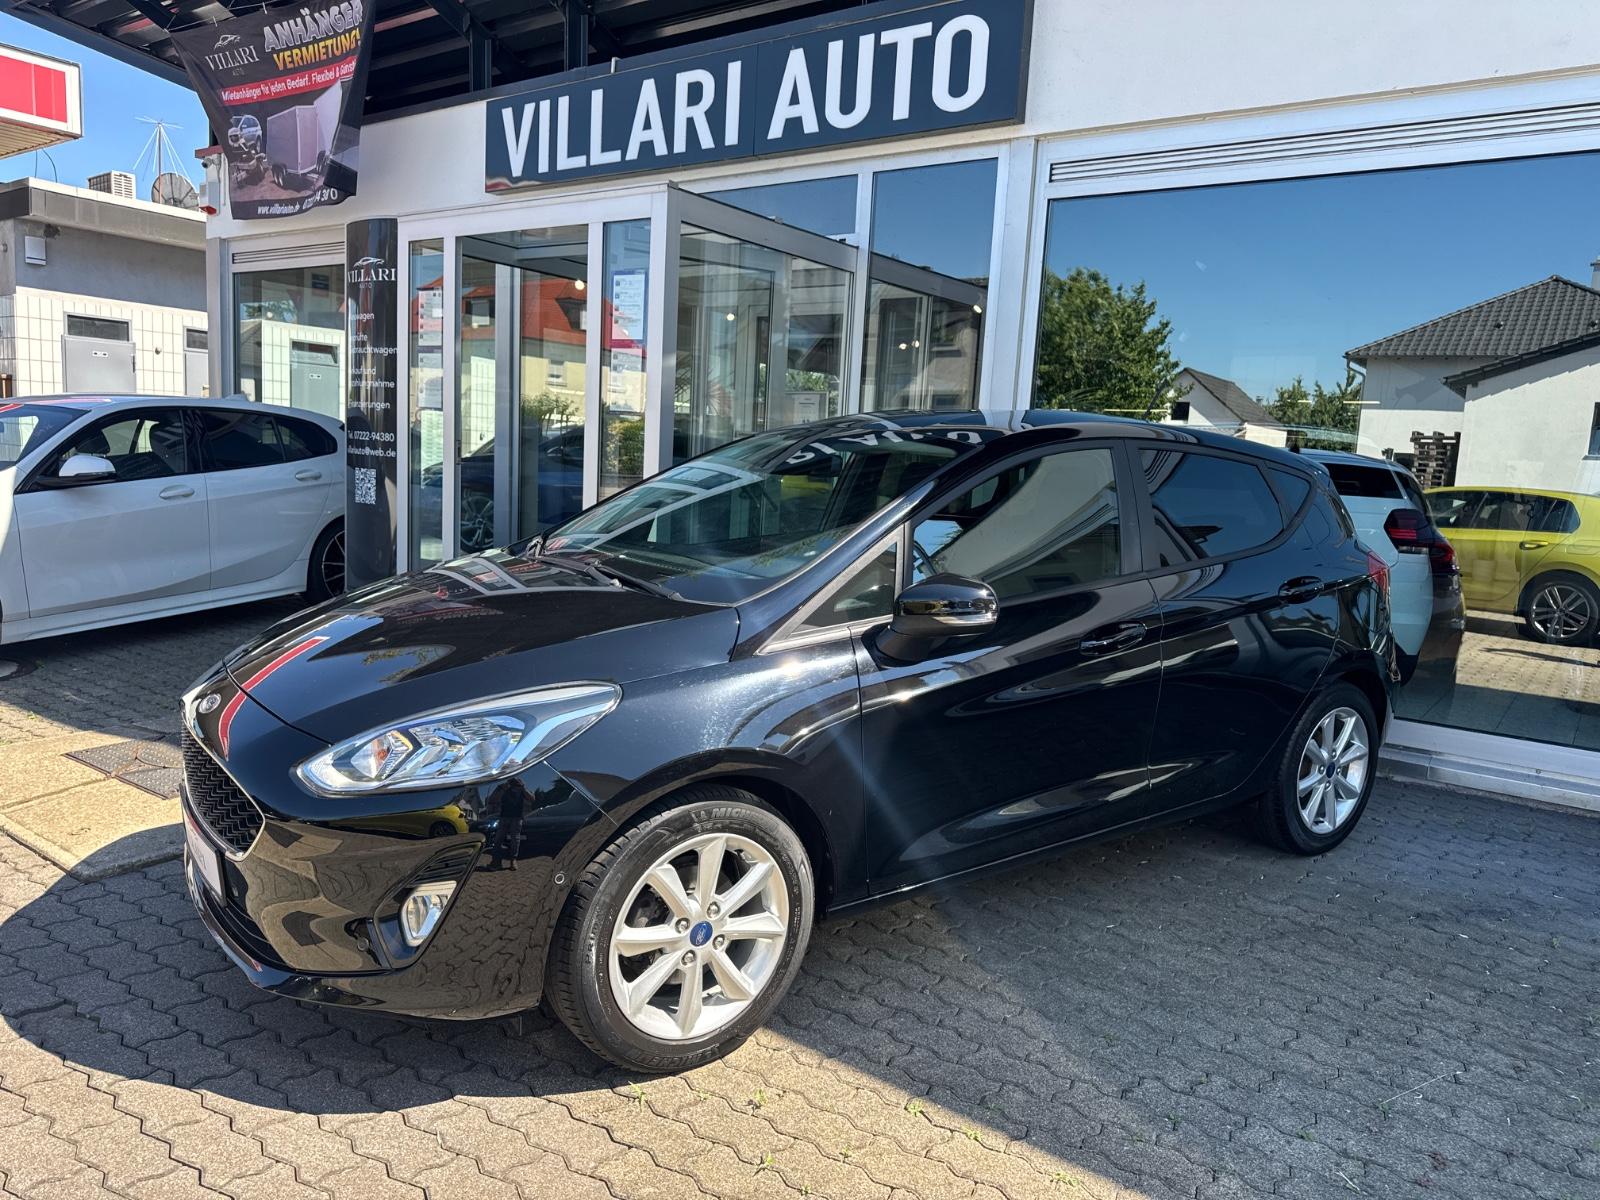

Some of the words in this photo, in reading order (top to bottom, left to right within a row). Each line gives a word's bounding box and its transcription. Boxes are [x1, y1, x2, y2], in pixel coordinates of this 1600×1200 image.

[263, 0, 364, 52] ANHÄNGER
[205, 45, 260, 71] VILLARI
[222, 86, 262, 101] Mietanhänger
[269, 82, 287, 96] jeden
[287, 77, 310, 90] Bedarf.
[312, 70, 335, 84] Flexibel
[501, 60, 742, 178] VILLARI
[767, 14, 990, 141] AUTO
[354, 430, 395, 442] 07222-94380
